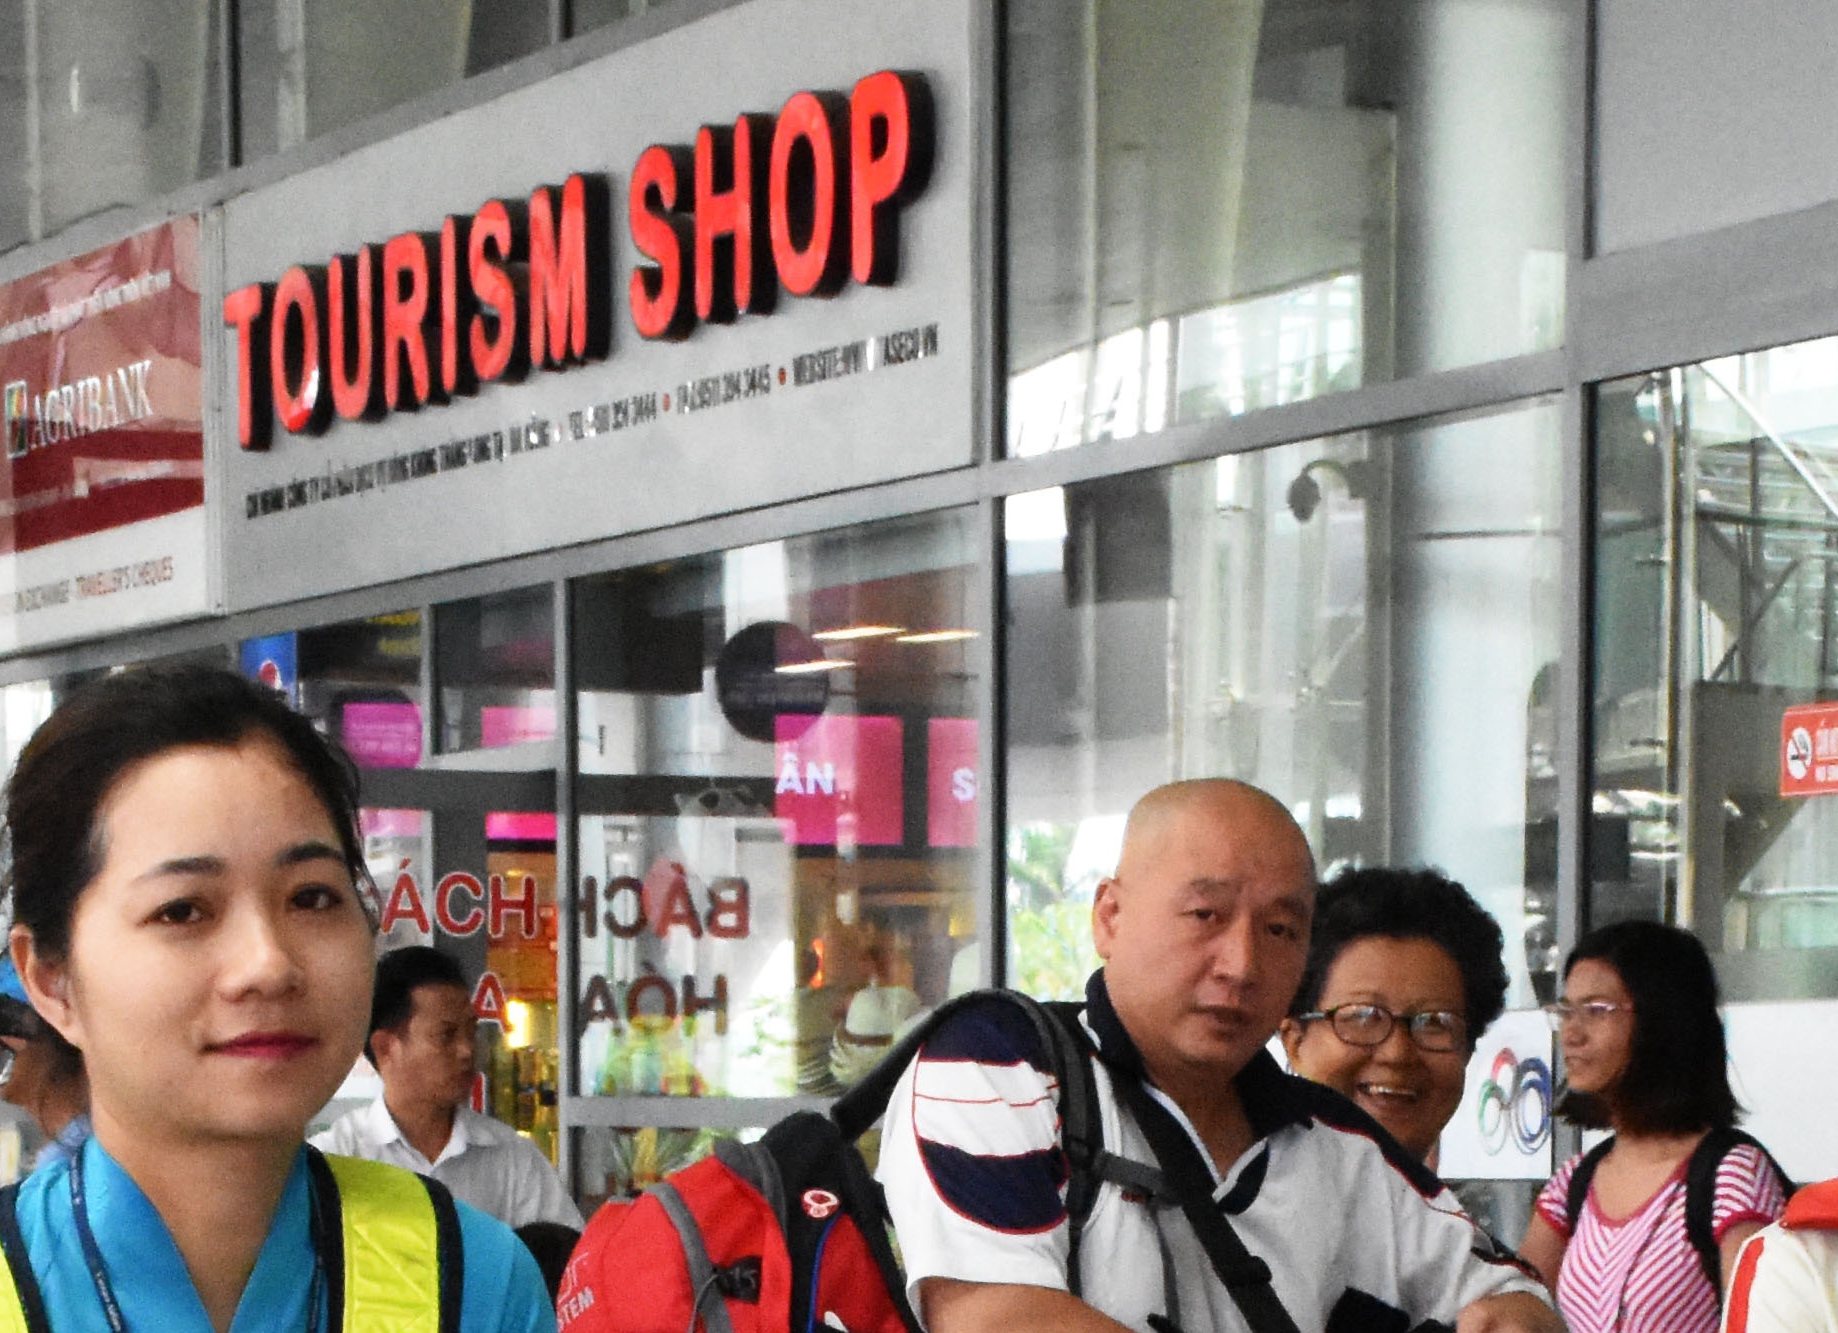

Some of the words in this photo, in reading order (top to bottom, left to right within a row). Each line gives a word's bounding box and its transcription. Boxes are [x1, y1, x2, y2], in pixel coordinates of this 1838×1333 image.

[223, 173, 610, 451] TOURISM
[629, 69, 935, 342] SHOP
[30, 359, 154, 450] AGRIBANK
[368, 857, 538, 938] ÁCH
